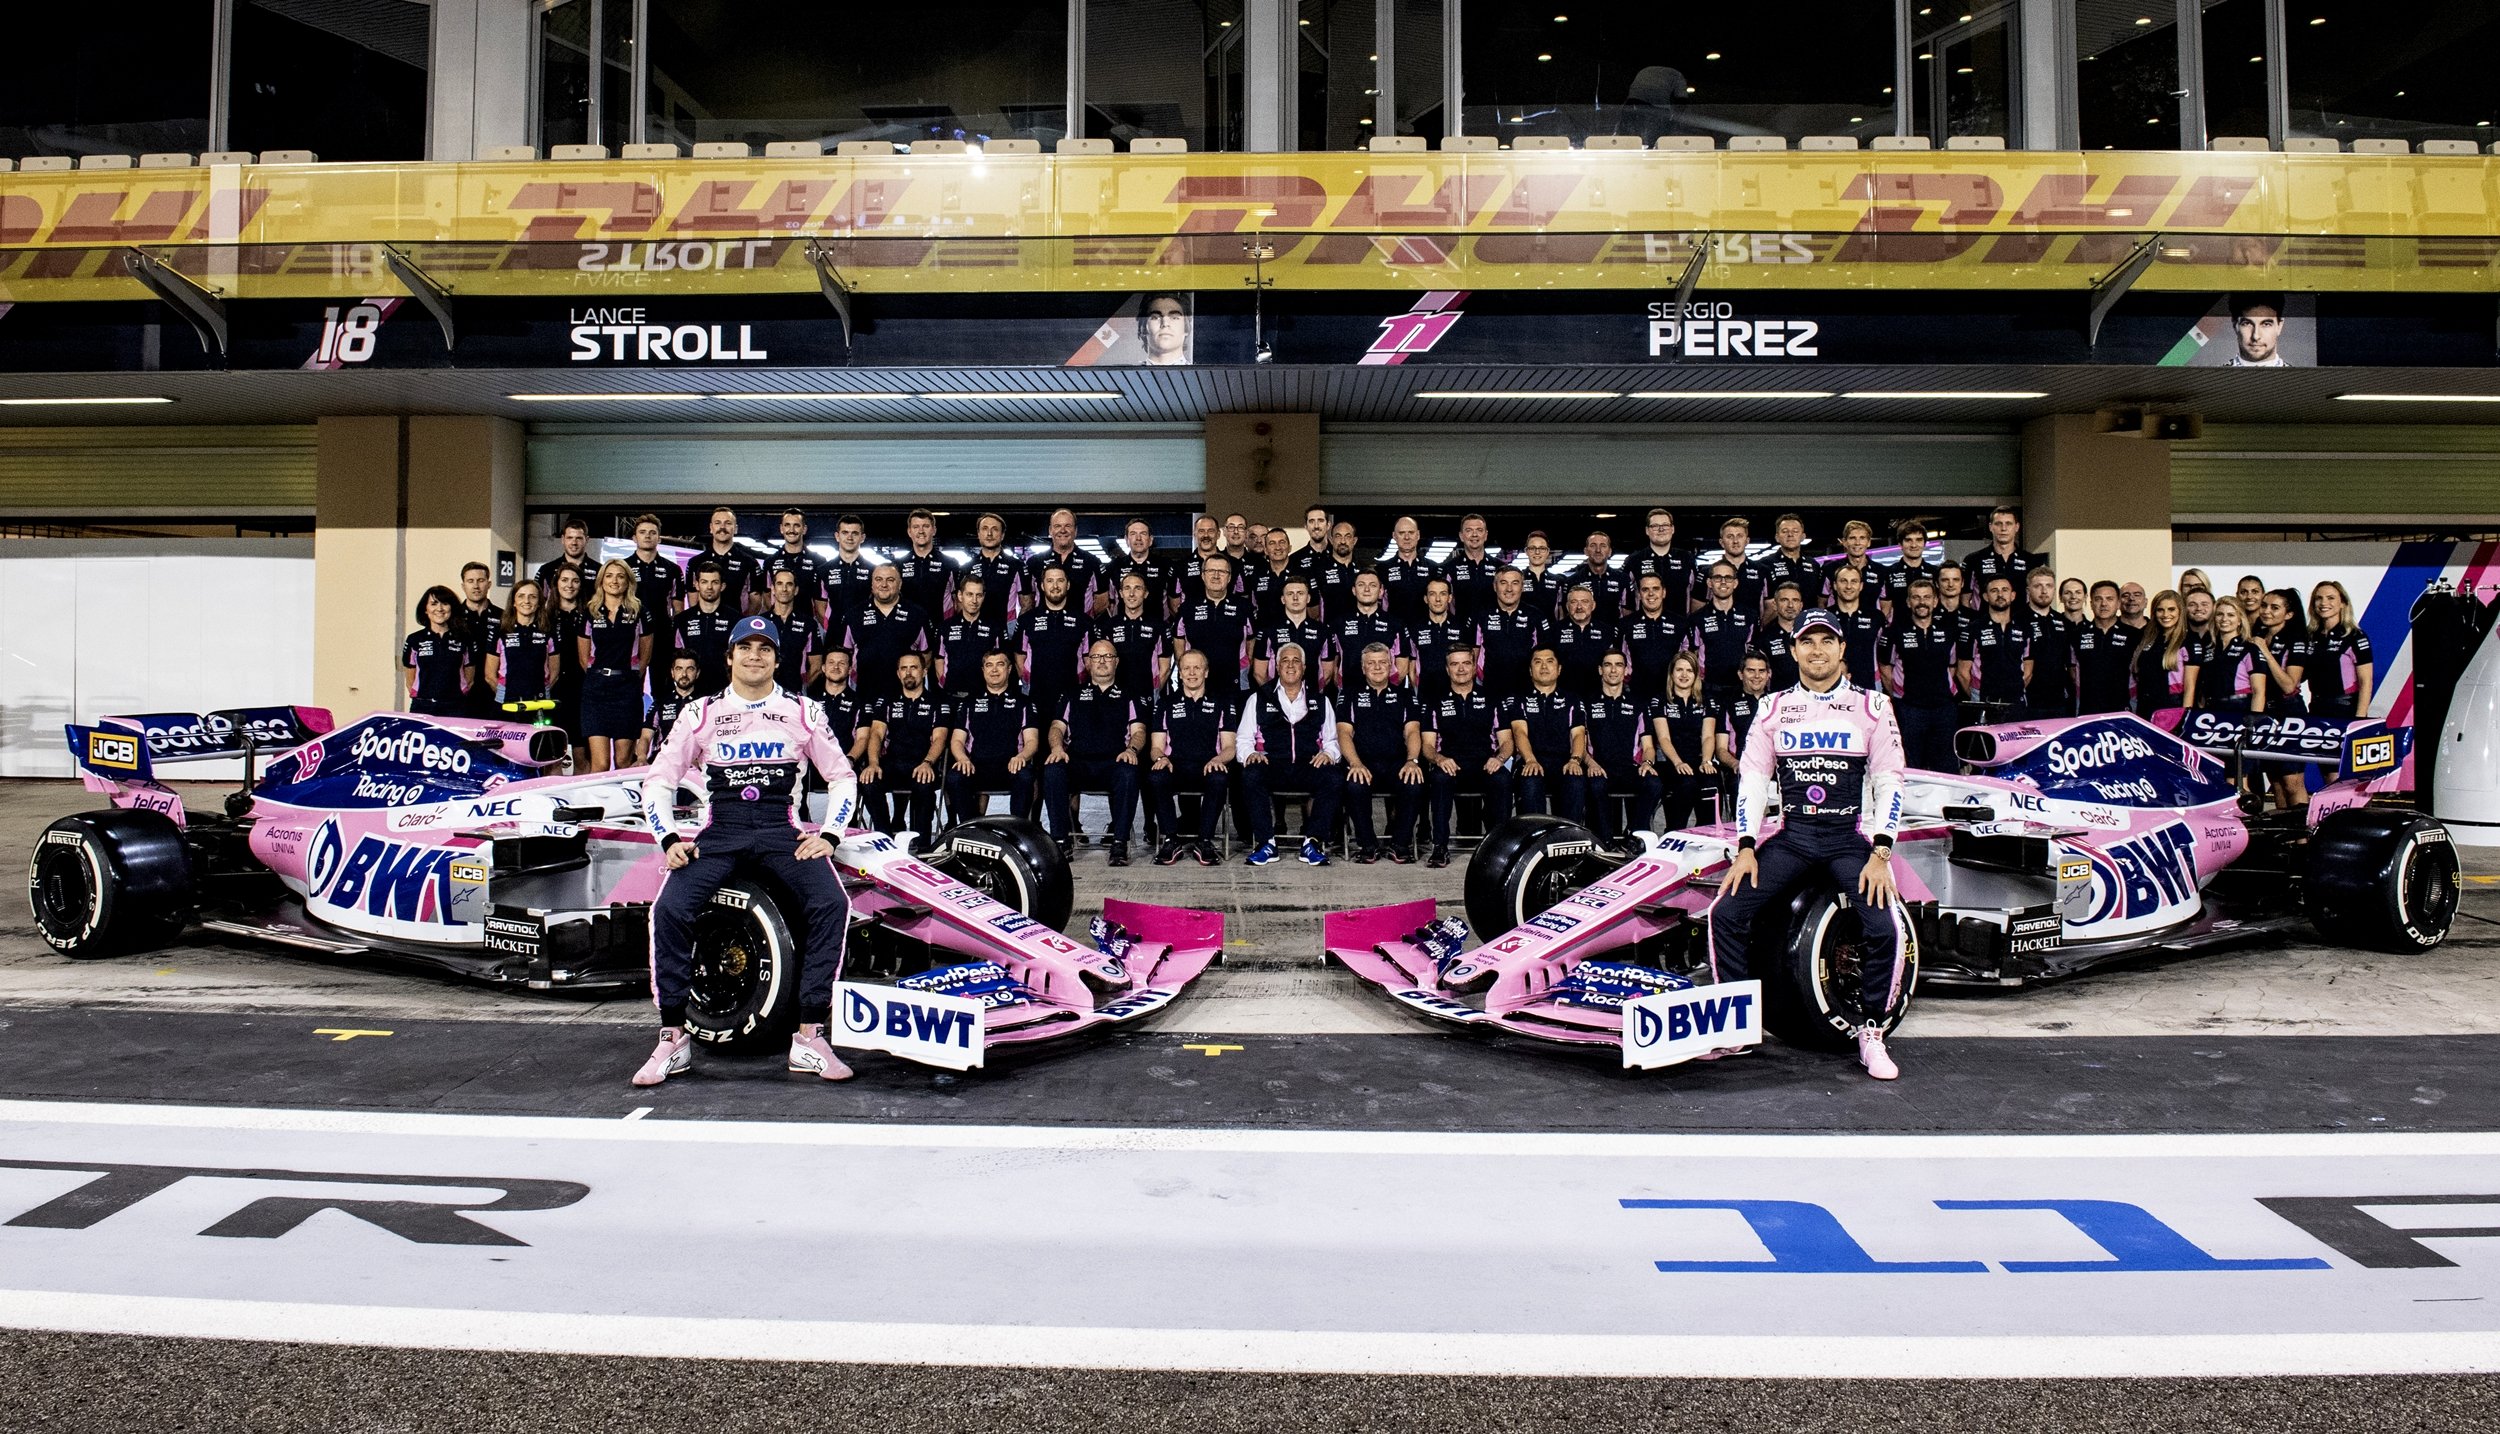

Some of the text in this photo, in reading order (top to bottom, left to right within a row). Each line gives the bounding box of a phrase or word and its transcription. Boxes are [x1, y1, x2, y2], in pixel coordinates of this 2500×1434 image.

[500, 180, 938, 268] DHL
[1156, 174, 1611, 264] DHL
[1833, 173, 2284, 263] DHL
[0, 188, 298, 277] HL
[570, 308, 645, 324] LANCE
[1647, 303, 1732, 320] SERGIO
[320, 306, 382, 363] 18
[1367, 311, 1464, 353] 11
[1648, 321, 1818, 357] PEREZ
[570, 325, 767, 360] STROLL
[501, 561, 513, 576] 28
[1782, 705, 1807, 713] JCB
[1828, 703, 1856, 712] NEC
[716, 714, 741, 725] JCB
[762, 713, 788, 723] NEC
[1780, 716, 1801, 724] Claro
[476, 729, 527, 741] BOMBARDIER
[717, 728, 737, 737] Claro
[1800, 732, 1851, 749] BWT
[2191, 713, 2346, 750] SportPes
[93, 742, 134, 762] JCB
[351, 727, 471, 773] SportPesa
[739, 742, 784, 759] BWT
[2048, 731, 2154, 777] SportPesa
[2356, 743, 2391, 766] JCB
[293, 743, 324, 784] 18
[1786, 757, 1848, 769] SportPesa
[1794, 771, 1837, 785] Racing
[352, 775, 405, 806] Racing
[2091, 780, 2143, 802] Racing
[133, 795, 174, 815] telcel
[467, 799, 522, 817] NEC
[1887, 791, 1904, 822] BWT
[2010, 792, 2051, 812] NEC
[399, 812, 437, 828] Claro
[837, 799, 852, 825] BWT
[2080, 808, 2115, 826] Claro
[543, 825, 572, 836] NEC
[650, 812, 667, 836] BWT
[1975, 823, 2002, 834] NEC
[2204, 826, 2237, 840] Acronis
[47, 831, 82, 846] PIRELLI
[265, 827, 302, 842] Acronis
[2415, 829, 2446, 845] PIRELLI
[867, 838, 897, 852] WT
[952, 838, 1002, 860] PIRELLI
[1657, 838, 1703, 852] BW
[453, 867, 483, 880] JCB
[1612, 861, 1661, 887] 11
[2062, 865, 2090, 879] JCB
[2105, 822, 2199, 920] BWT
[328, 836, 475, 926] BWT
[941, 887, 976, 900] JCB
[1585, 886, 1622, 899] JCB
[960, 896, 994, 909] NEC
[1569, 895, 1606, 909] NEC
[487, 922, 538, 935] RAVENOL
[1017, 927, 1052, 941] infinitum
[1515, 927, 1554, 940] infinitum
[2015, 919, 2061, 932] RAVENOL
[485, 935, 539, 955] HACKETT
[2011, 935, 2062, 953] HACKETT
[759, 958, 771, 982] LS
[886, 1001, 975, 1048] BWT
[1668, 994, 1752, 1041] BWT
[684, 1013, 756, 1043] P ZER
[1618, 1198, 2334, 1273] 11
